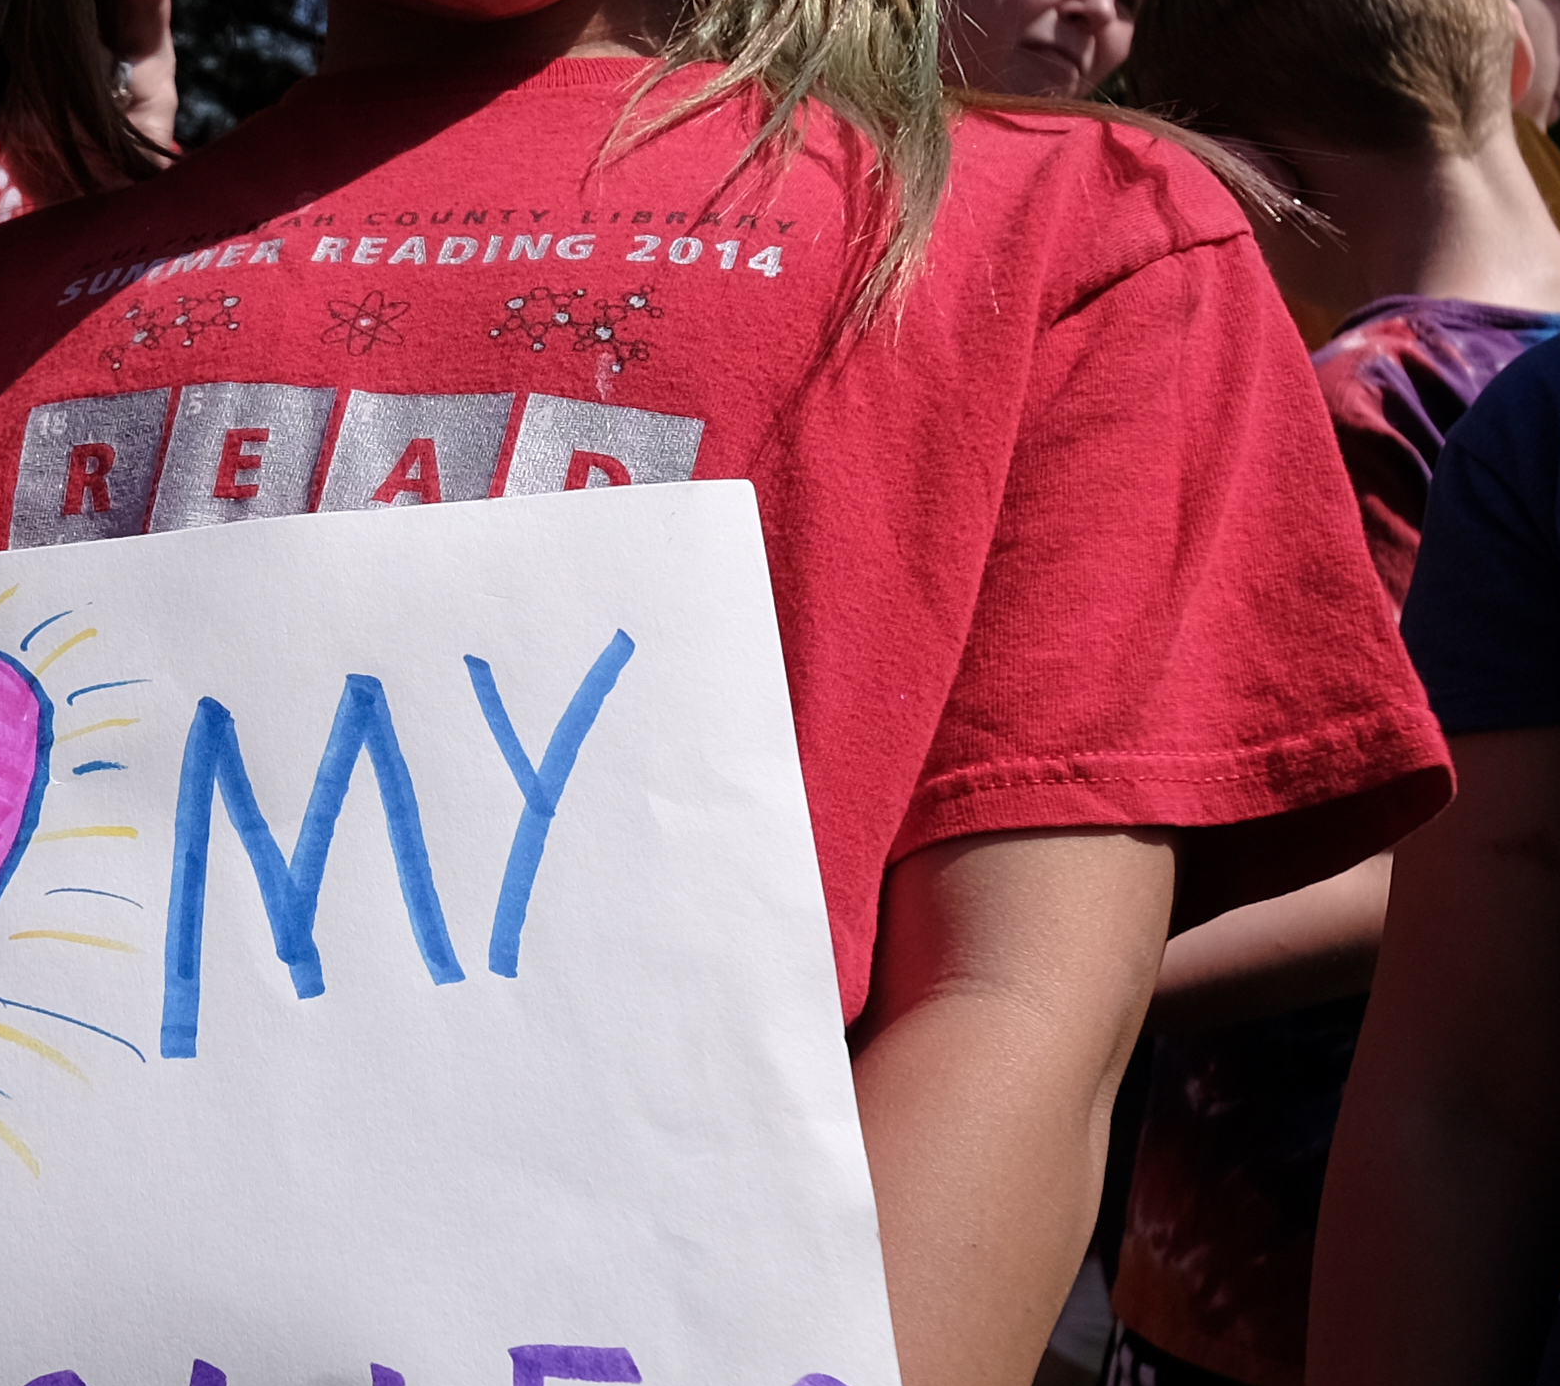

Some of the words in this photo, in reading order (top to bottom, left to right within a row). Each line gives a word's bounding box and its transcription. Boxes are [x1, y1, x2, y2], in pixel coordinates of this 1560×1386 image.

[364, 209, 551, 227] COUNTY
[580, 210, 797, 235] LIBRARY
[56, 237, 285, 307] SUMMER
[311, 234, 597, 265] READING
[626, 234, 783, 278] 2014
[160, 628, 636, 1059] MY
